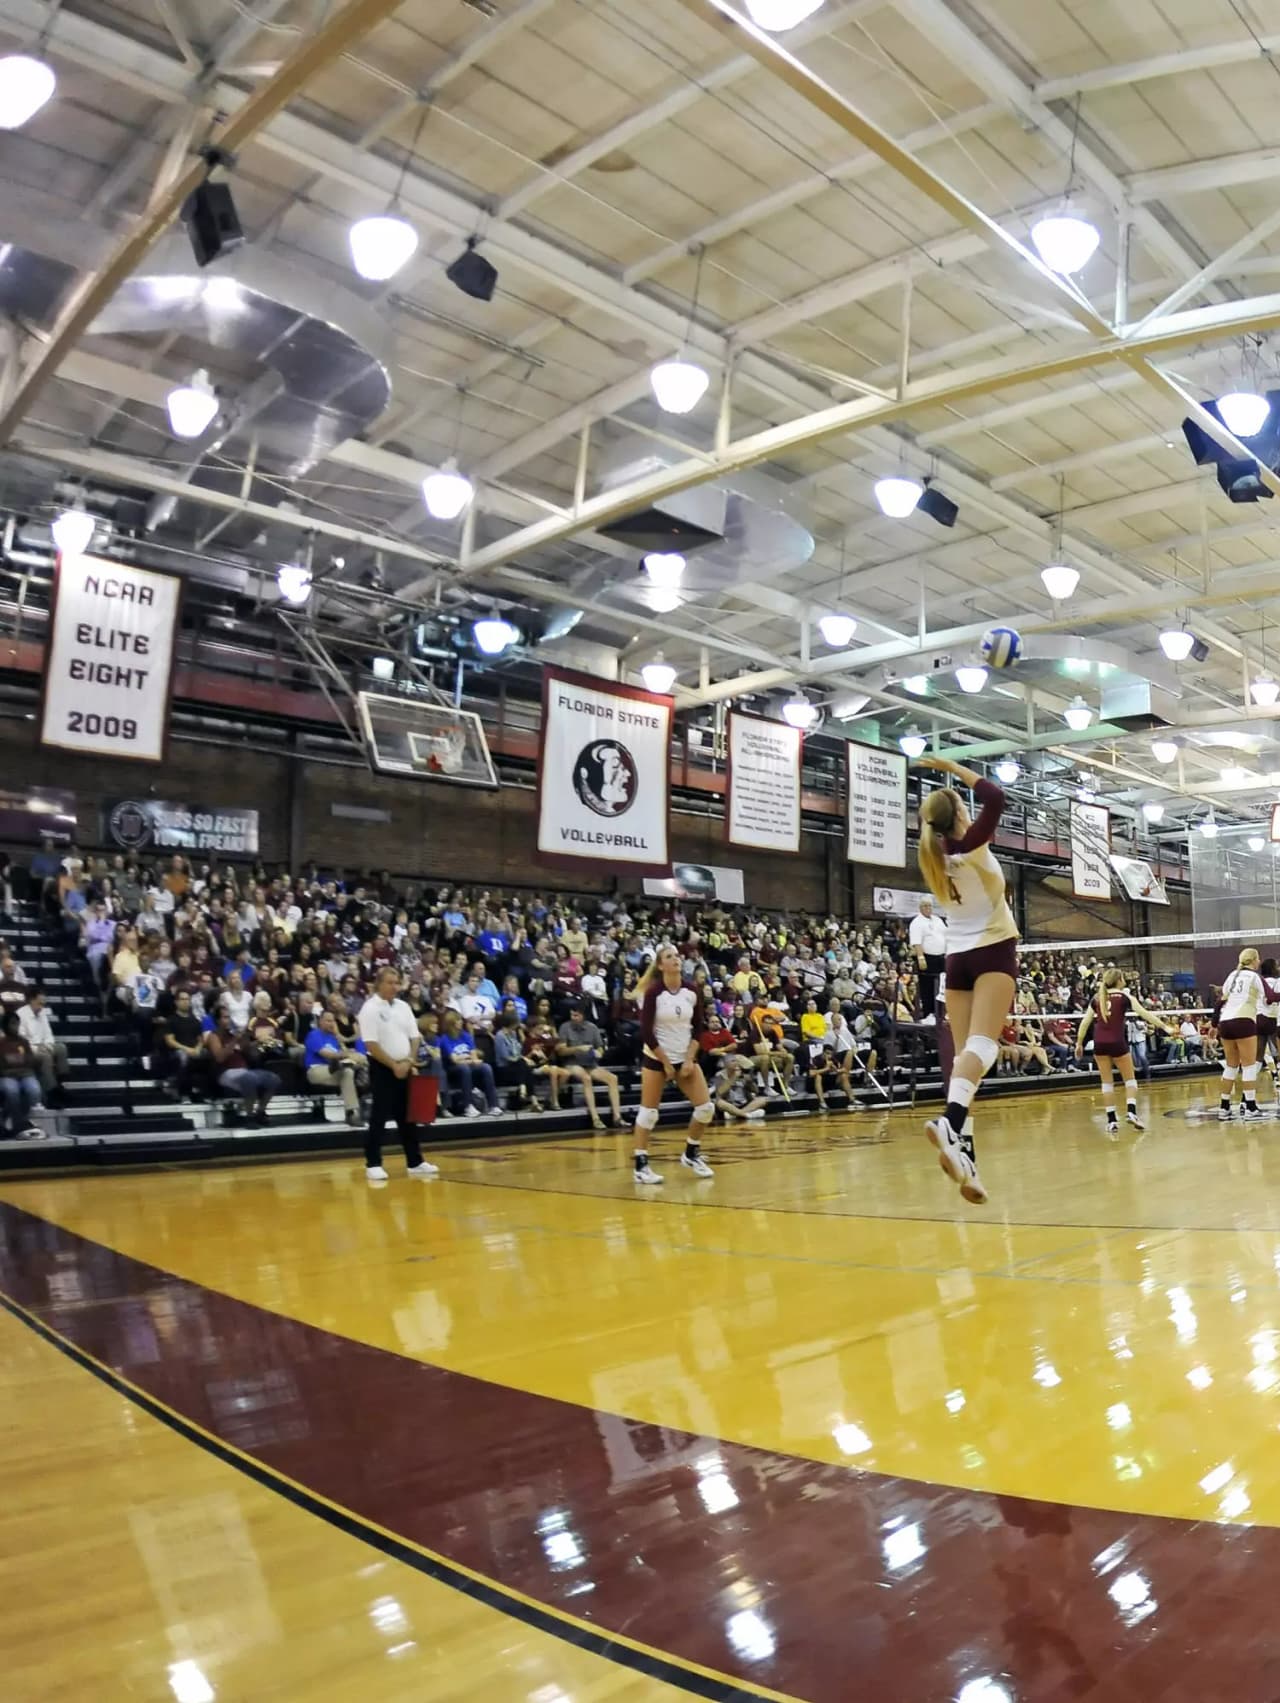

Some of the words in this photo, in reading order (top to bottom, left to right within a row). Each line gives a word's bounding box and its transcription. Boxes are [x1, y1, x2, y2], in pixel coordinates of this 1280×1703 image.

[85, 575, 154, 606] NCAA
[76, 623, 149, 654] ELITE
[69, 659, 149, 690] EIGHT
[67, 711, 137, 740] 2009
[558, 696, 614, 719] FLORIDA
[618, 711, 660, 729] STATE
[560, 827, 648, 849] VOLLEYBALL
